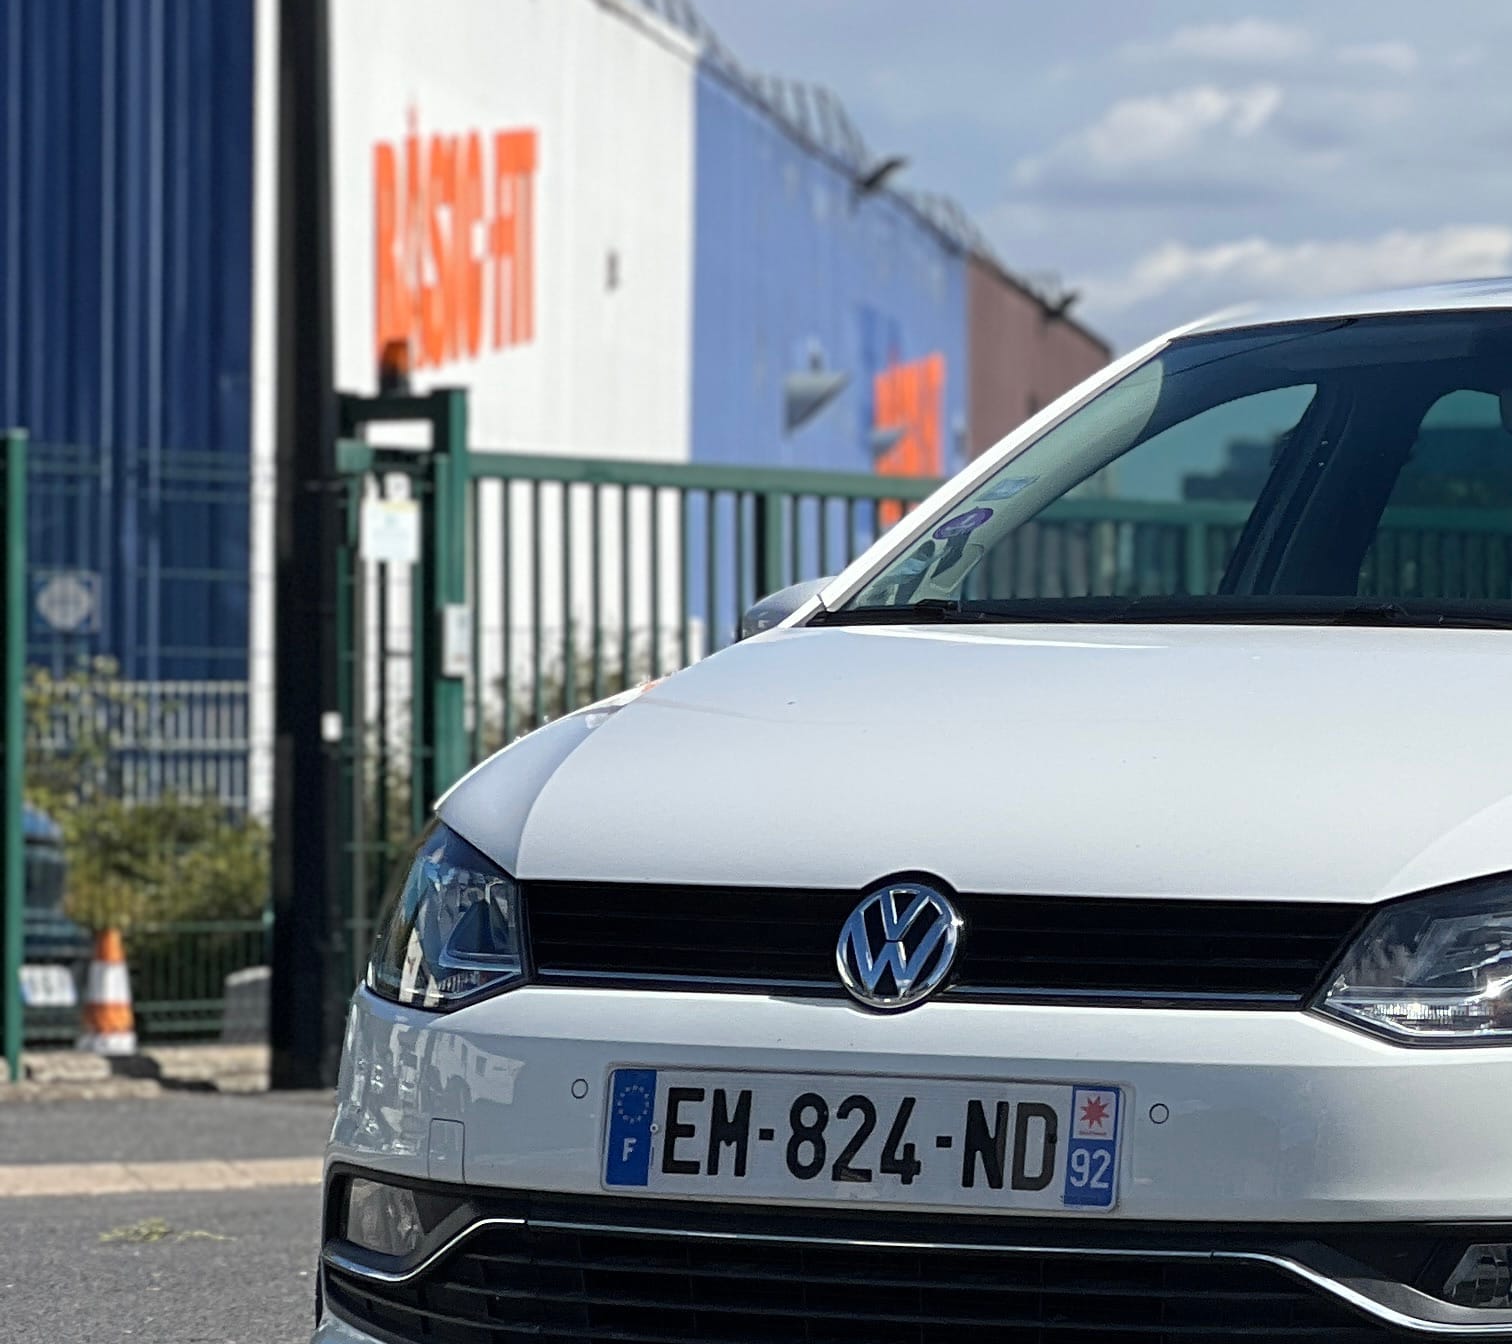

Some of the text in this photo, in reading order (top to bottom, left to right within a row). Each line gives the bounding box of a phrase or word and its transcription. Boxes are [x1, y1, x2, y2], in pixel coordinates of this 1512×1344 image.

[837, 883, 957, 1008] VW
[622, 1087, 1111, 1191] F EM-824-ND 92
